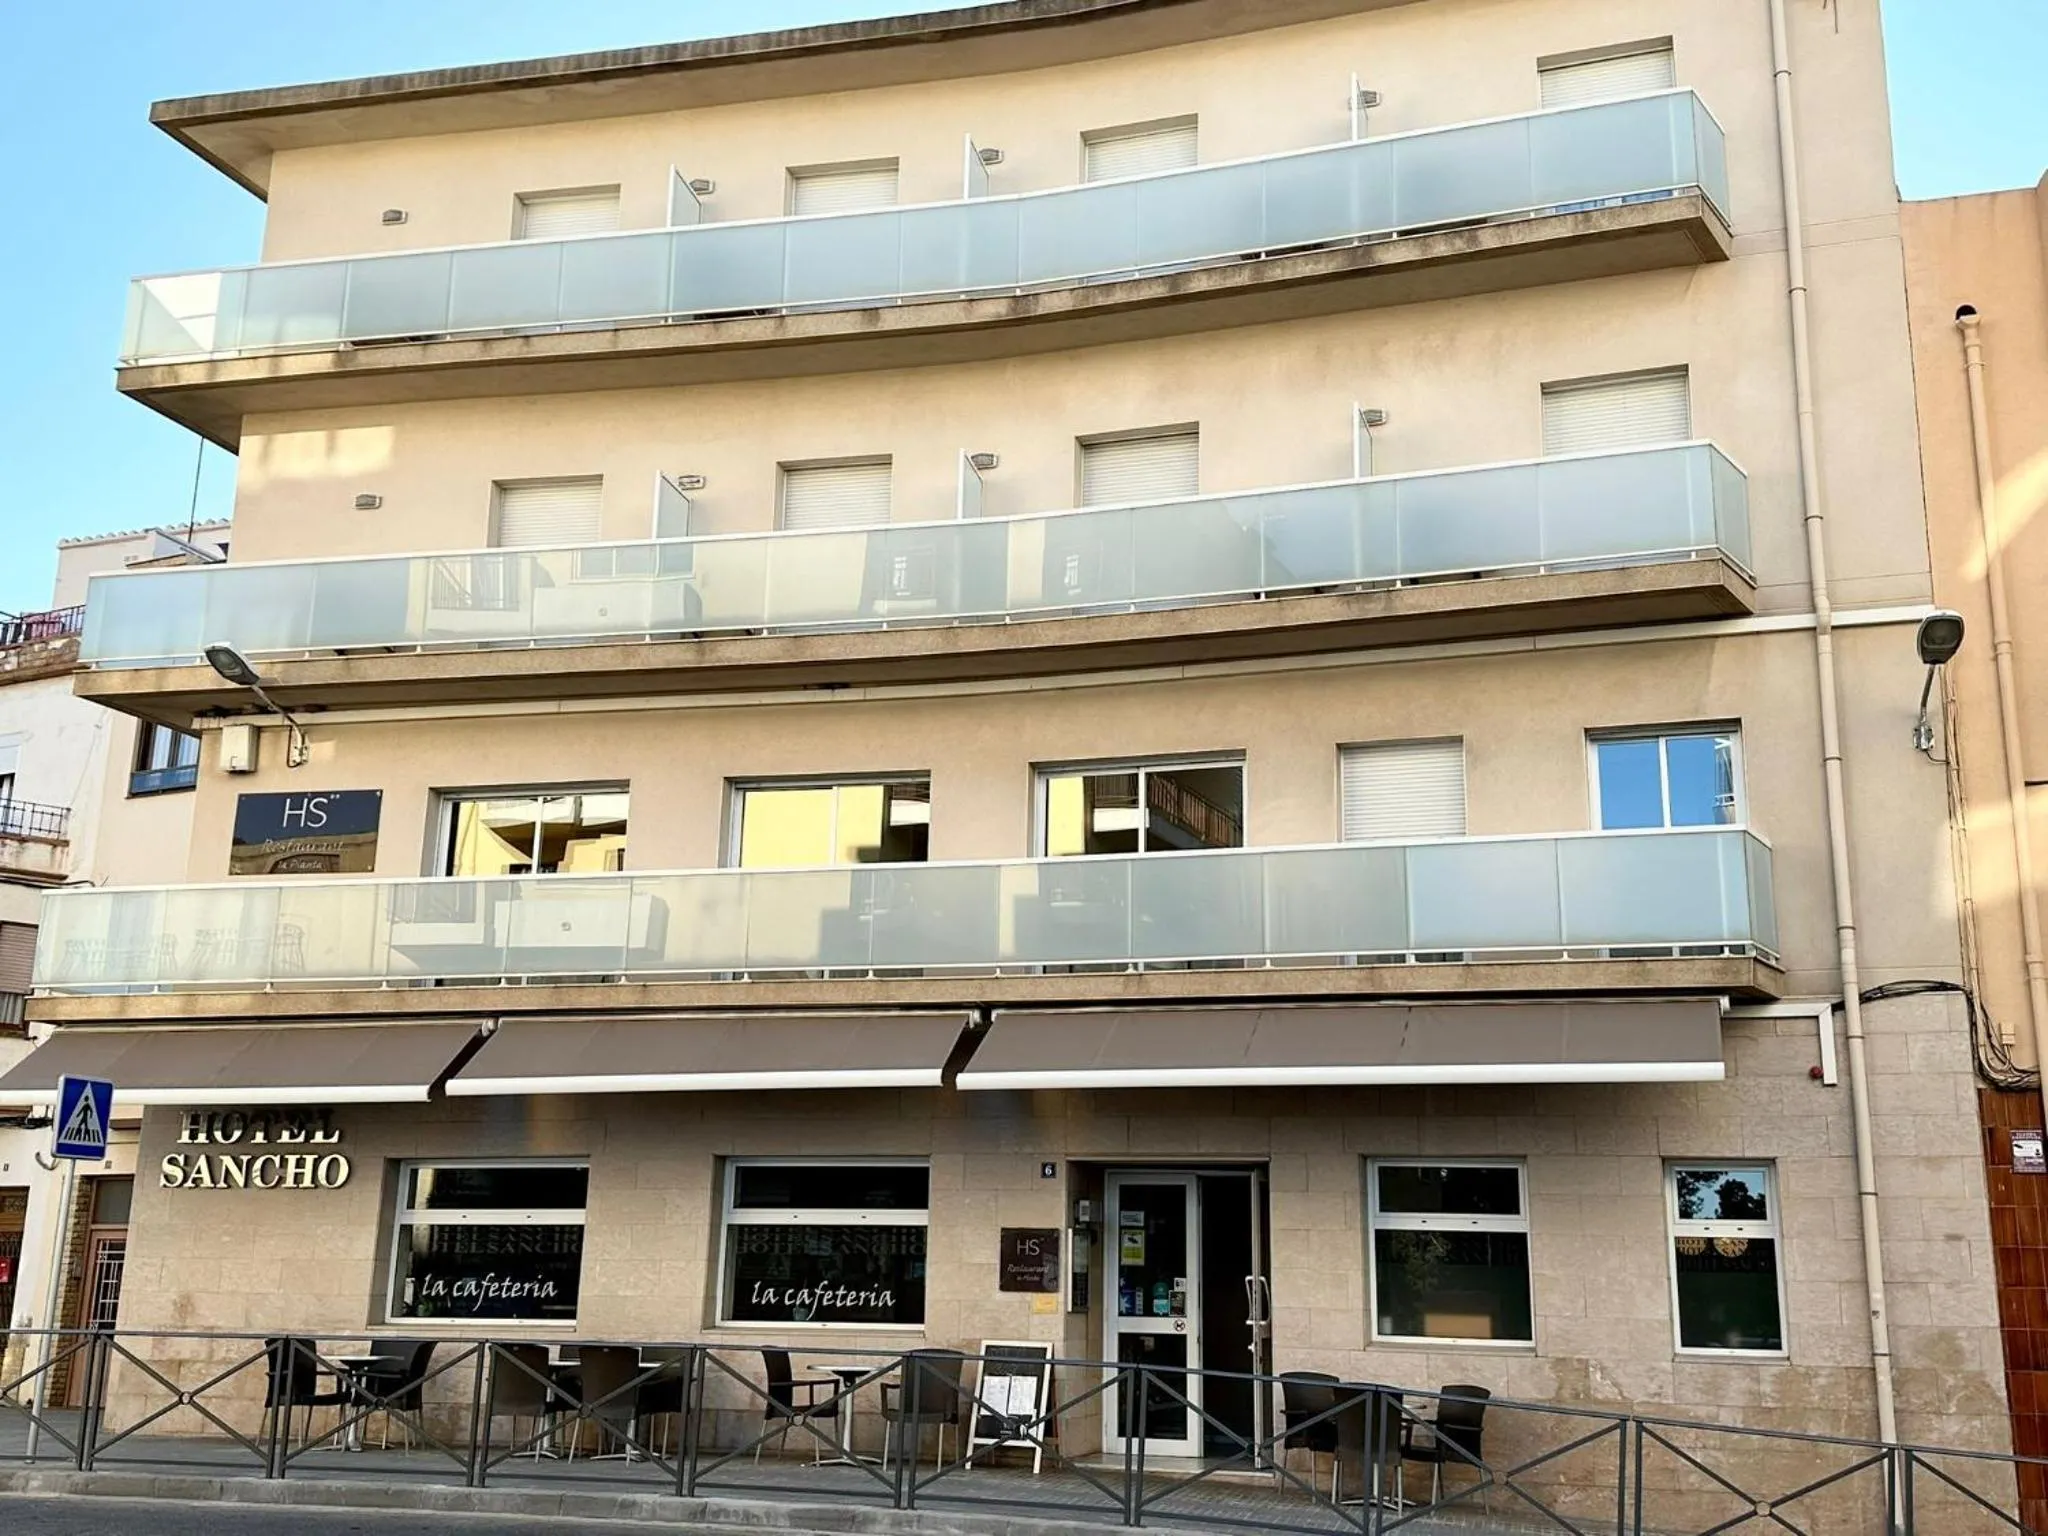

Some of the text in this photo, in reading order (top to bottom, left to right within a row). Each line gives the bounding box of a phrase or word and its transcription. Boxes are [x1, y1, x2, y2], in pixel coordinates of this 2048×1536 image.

[177, 1109, 341, 1145] HOTEL
[160, 1153, 349, 1189] SANCHO
[1045, 1165, 1052, 1176] 6
[422, 1272, 558, 1312] la cafeteria
[752, 1280, 896, 1321] la cafeteria
